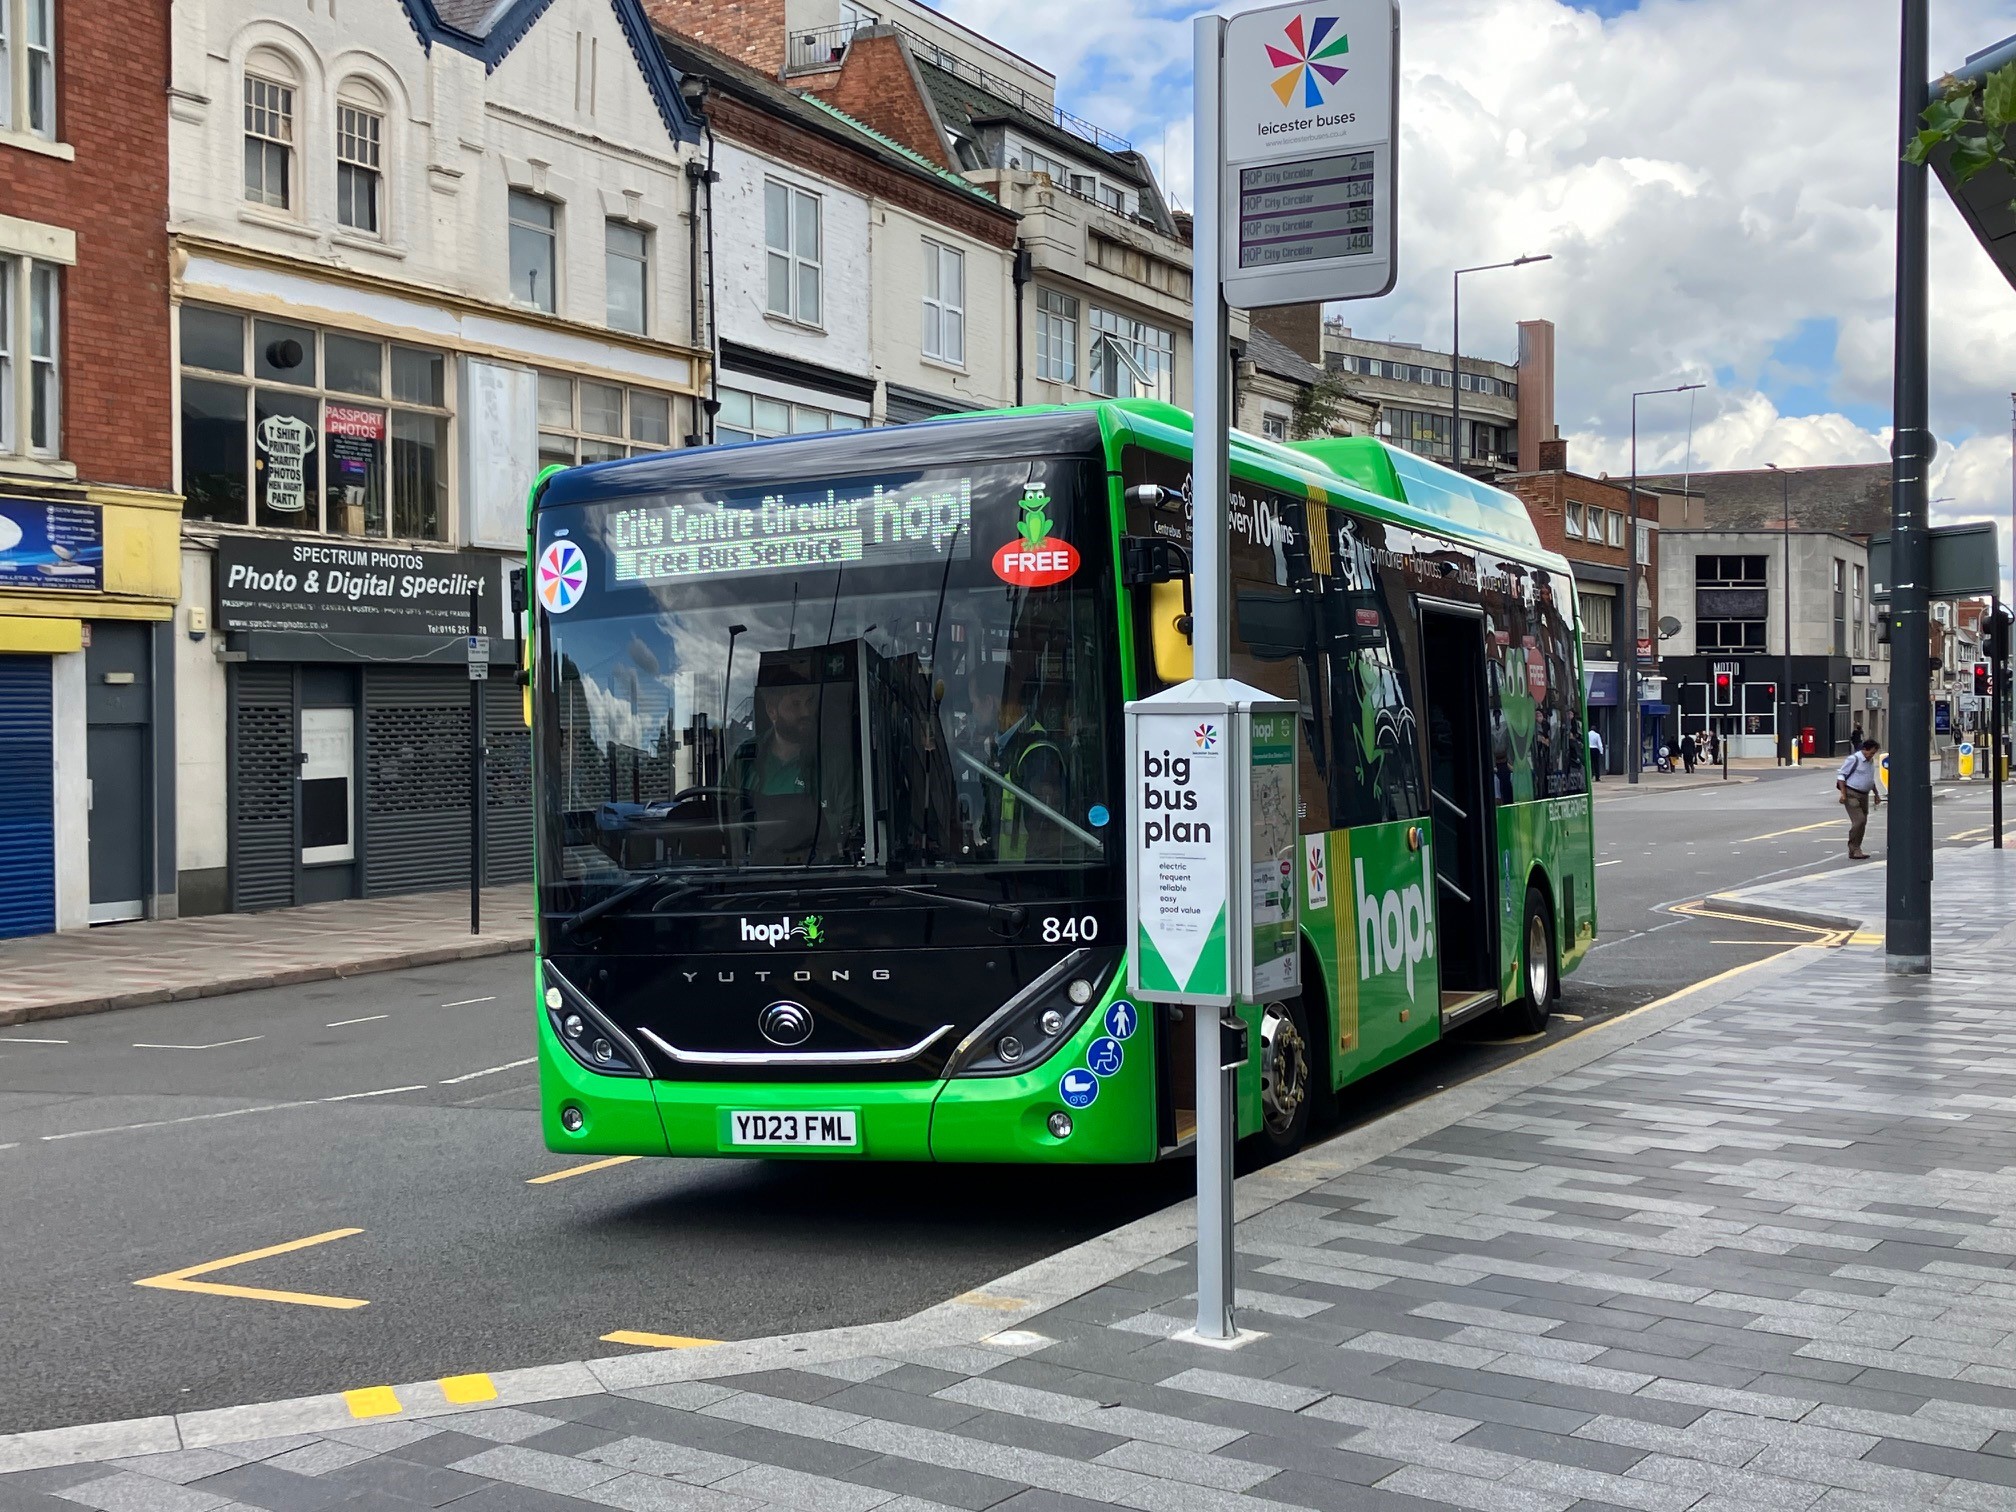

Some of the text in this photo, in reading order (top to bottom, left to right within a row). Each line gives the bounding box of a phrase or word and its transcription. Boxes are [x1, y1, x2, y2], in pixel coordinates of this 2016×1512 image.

[1258, 112, 1356, 136] leicester buses
[1243, 158, 1374, 186] HOP City Circular 2 min
[1243, 181, 1374, 212] HOP City Circular 13:40
[1243, 208, 1374, 237] HOP City Circular 13:50
[1243, 234, 1373, 262] HOP City Circular 14:00
[326, 406, 382, 425] PASSPORT
[268, 426, 300, 440] T SHIRT
[332, 422, 376, 439] PHOTOS
[268, 440, 300, 455] PRINTING
[270, 454, 300, 467] CHARITY
[269, 467, 301, 480] PHOTOS
[272, 492, 298, 506] PARTY
[616, 490, 862, 547] City Centre Circular
[874, 478, 970, 552] hop!
[292, 546, 424, 570] SPECTRUM PHOTOS
[636, 539, 842, 576] Free Bus Service
[1003, 550, 1069, 573] FREE
[228, 564, 486, 600] Photo & Digital Specilist
[450, 610, 470, 618] FRAMIN
[1714, 662, 1740, 676] MOTTO
[1252, 718, 1274, 744] hop!
[1144, 750, 1190, 786] big
[1144, 782, 1198, 810] bus
[1144, 814, 1211, 849] plan
[1159, 873, 1191, 882] frequent
[1160, 862, 1187, 870] electric
[1160, 884, 1187, 892] reliable
[1160, 896, 1177, 904] easy
[1160, 906, 1201, 914] good value
[740, 916, 791, 948] hop!
[1042, 916, 1098, 943] 840
[1354, 844, 1434, 1005] hop!
[682, 969, 890, 983] YUTONG
[737, 1116, 852, 1141] YD23 FML
